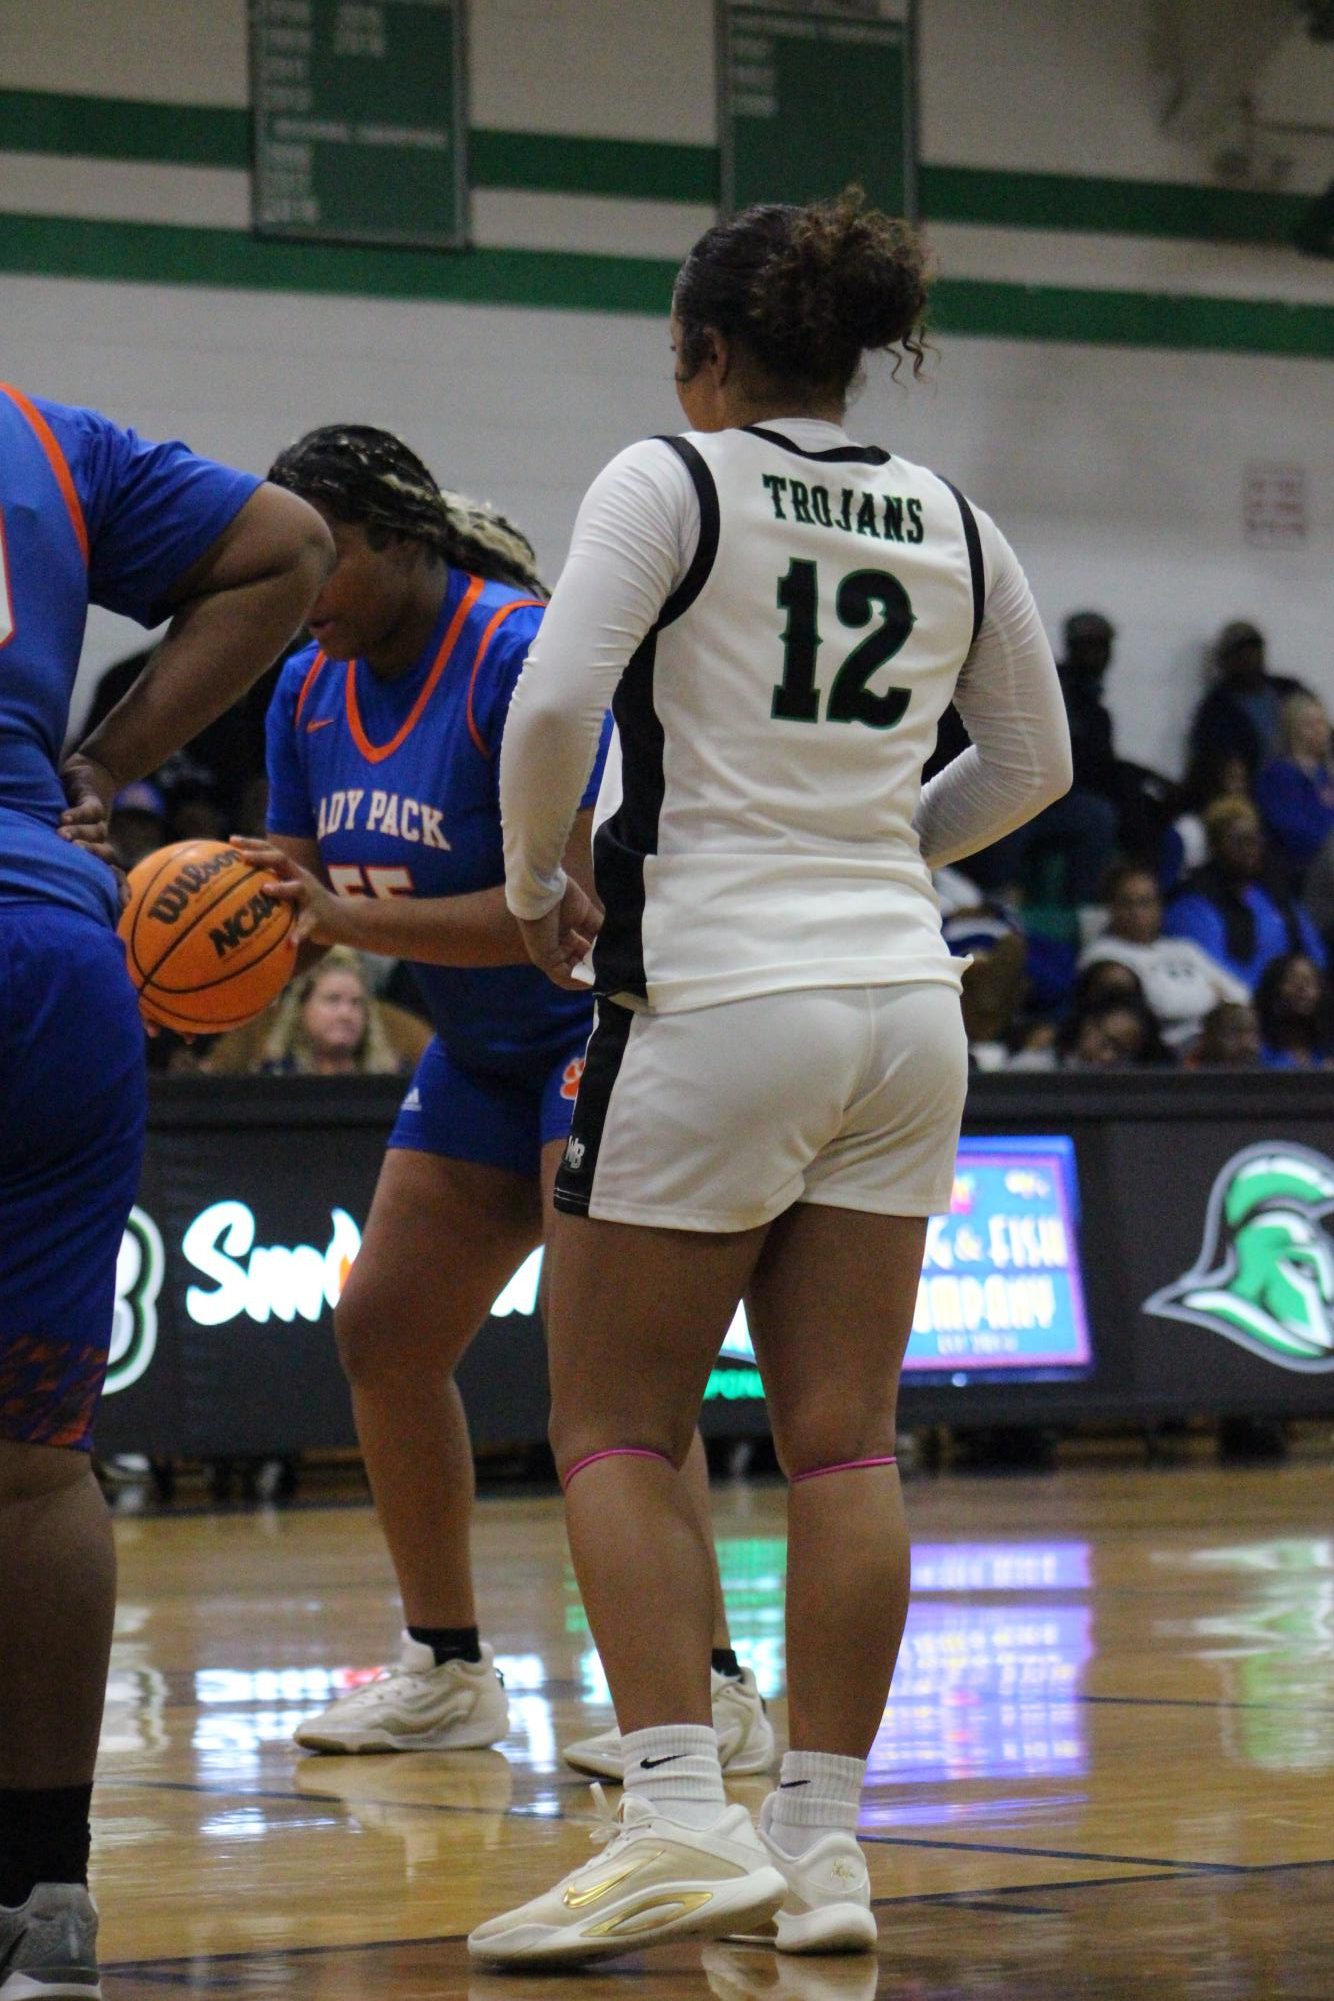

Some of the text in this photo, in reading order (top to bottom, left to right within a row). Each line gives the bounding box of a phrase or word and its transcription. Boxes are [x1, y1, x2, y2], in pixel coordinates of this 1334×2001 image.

[762, 474, 924, 545] TROJANS
[771, 557, 918, 730] 12
[366, 790, 452, 851] PACK
